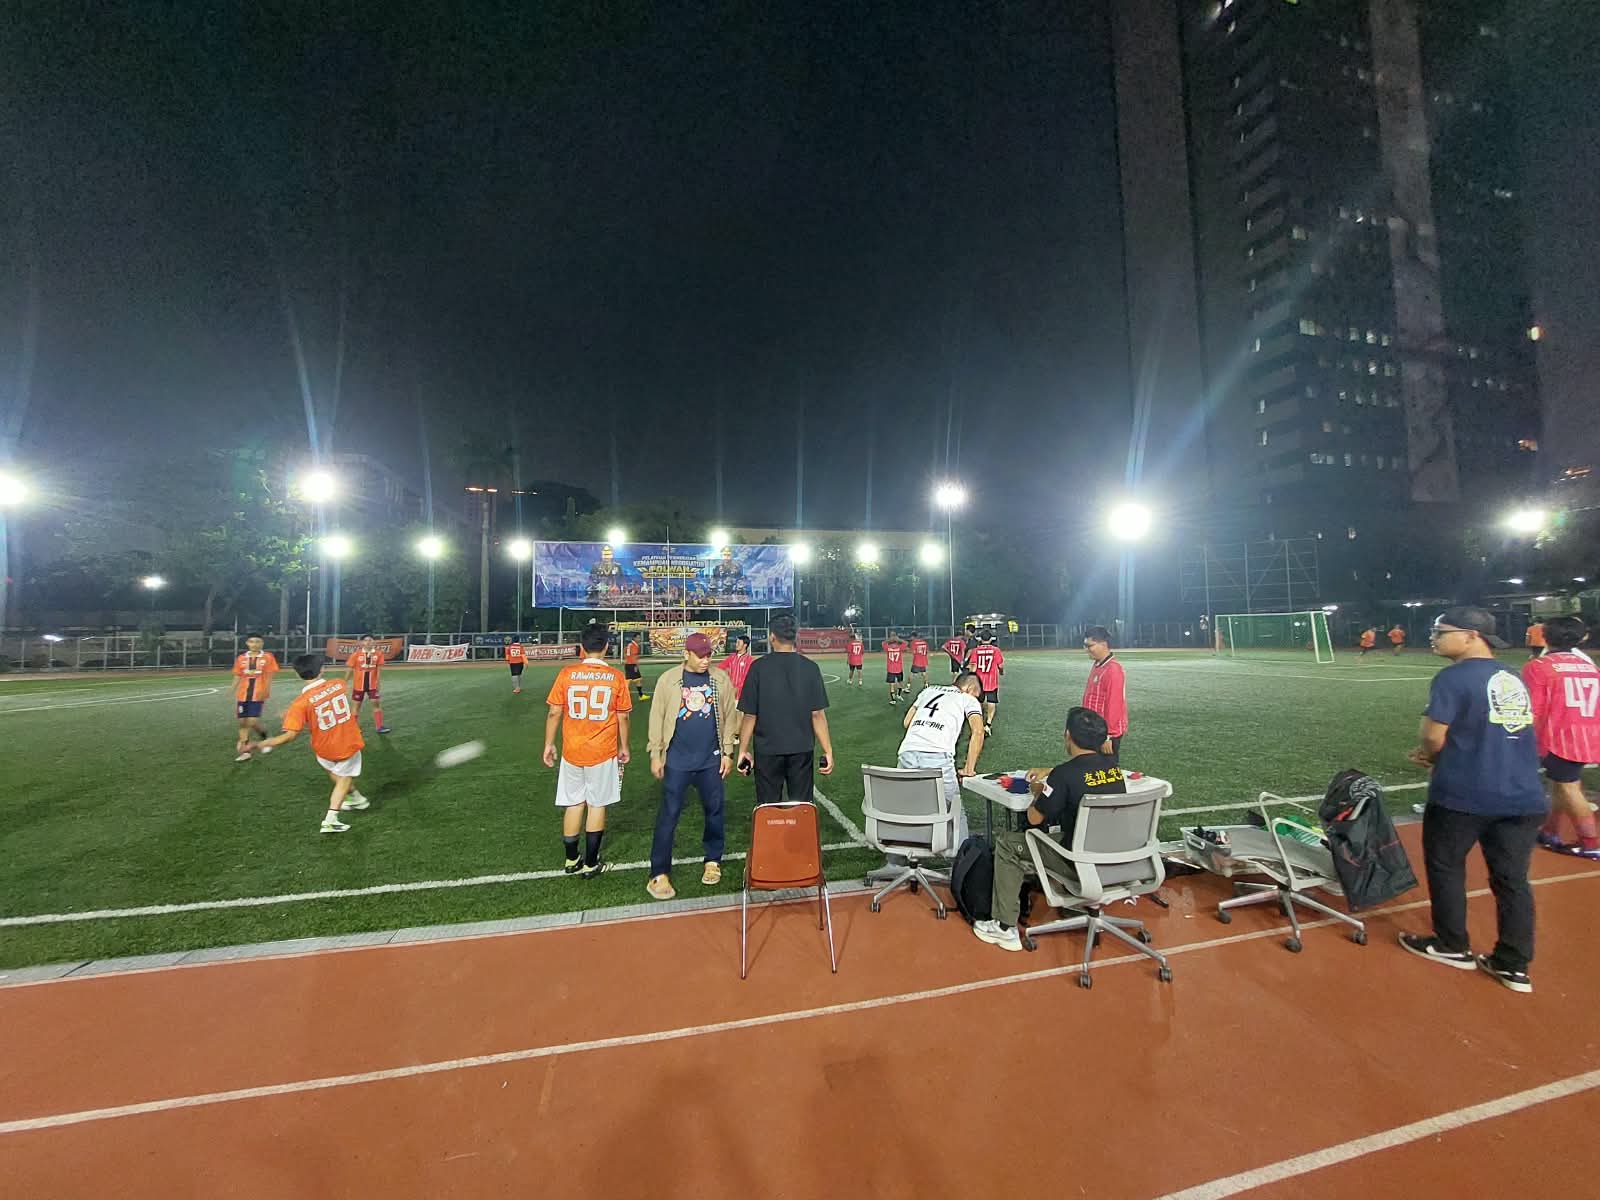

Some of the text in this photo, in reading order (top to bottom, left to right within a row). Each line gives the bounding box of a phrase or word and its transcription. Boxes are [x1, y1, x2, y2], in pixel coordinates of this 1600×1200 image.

[724, 620, 746, 628] JAYA
[853, 645, 862, 655] 47
[950, 643, 960, 655] 47
[888, 652, 900, 663] 47
[977, 655, 993, 673] 47
[571, 671, 614, 681] RAWASARI
[567, 685, 612, 721] 69
[1563, 677, 1599, 718] 47
[315, 693, 352, 731] 69
[923, 693, 945, 718] 4
